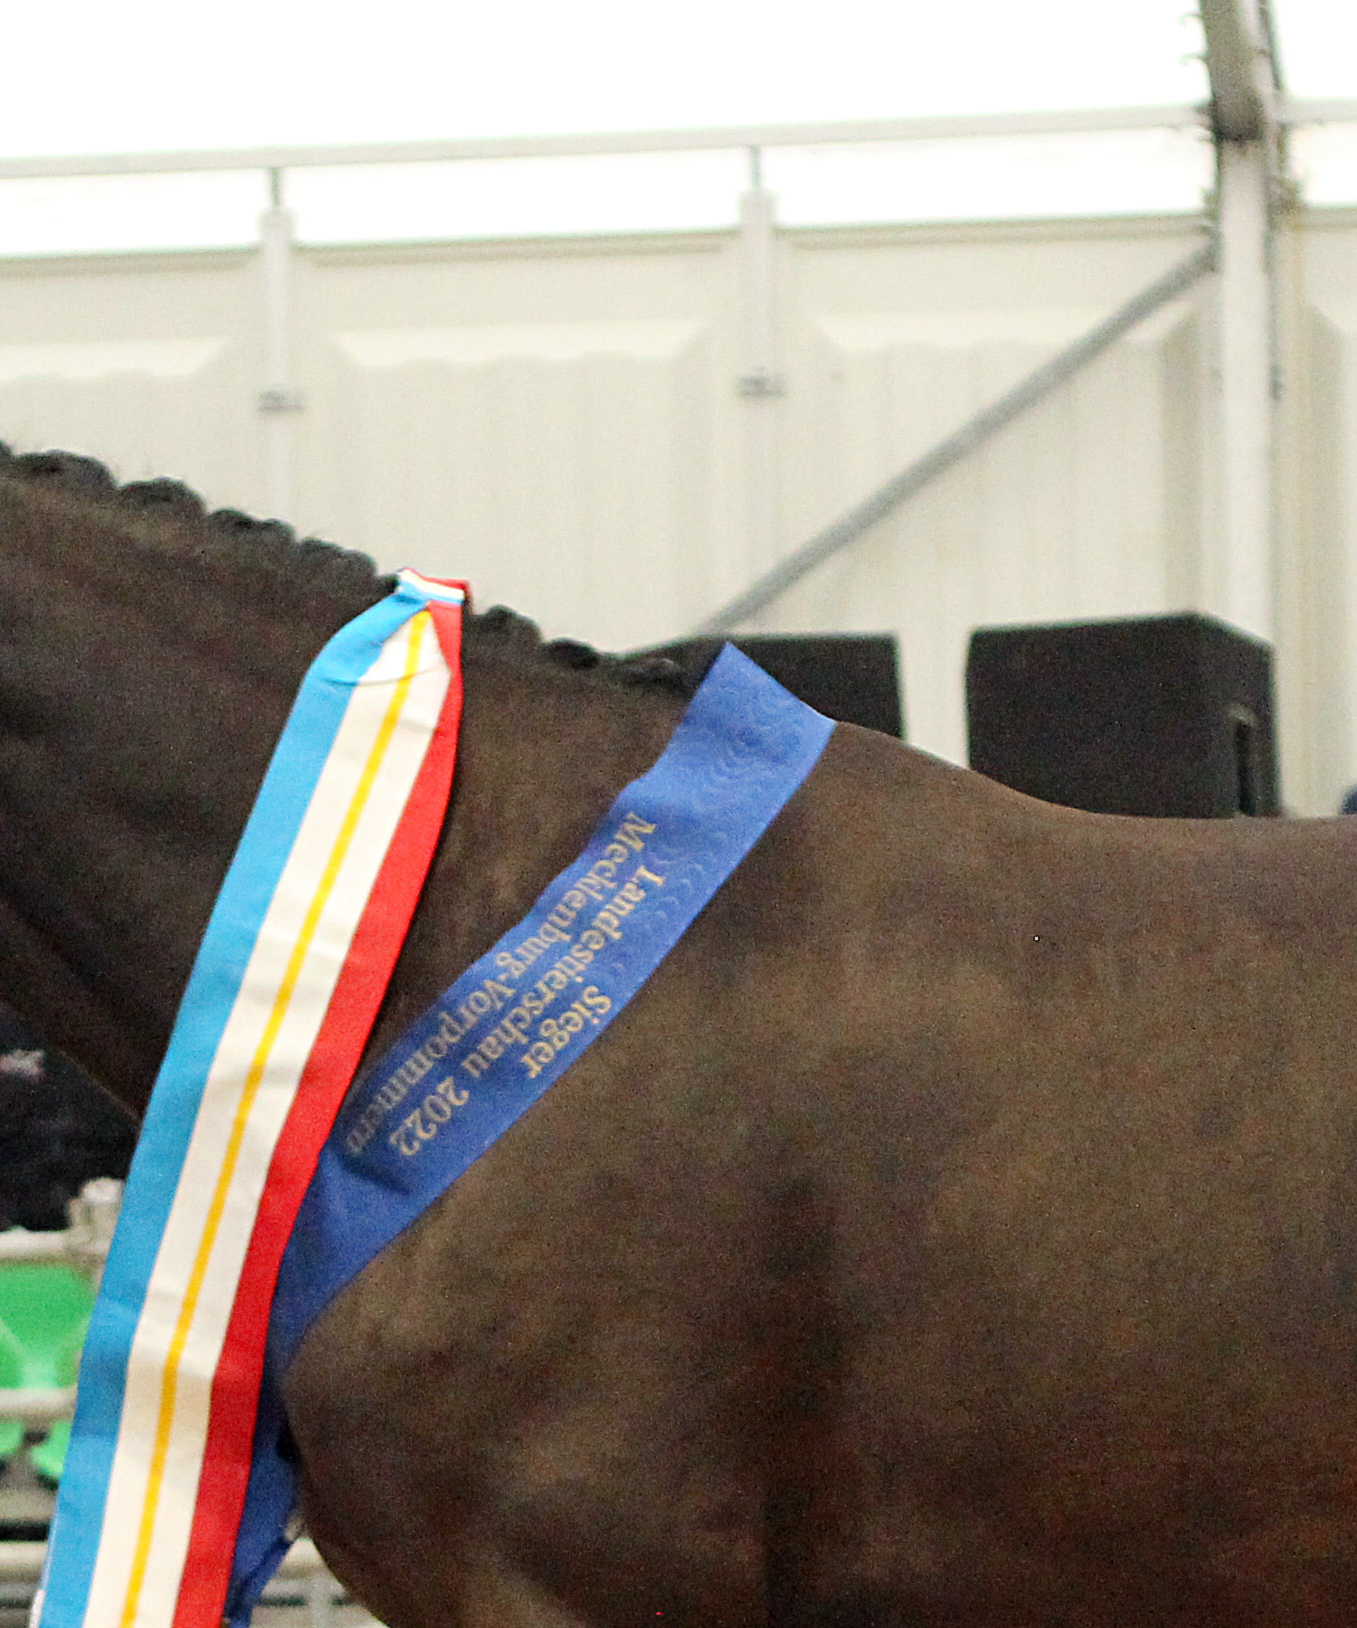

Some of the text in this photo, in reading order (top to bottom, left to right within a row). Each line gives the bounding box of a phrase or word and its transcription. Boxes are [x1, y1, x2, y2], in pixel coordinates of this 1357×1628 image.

[345, 812, 657, 1154] Mecklenburg-Vorpommern
[388, 864, 666, 1157] Landestierschau 2022
[519, 984, 612, 1080] Sieger
